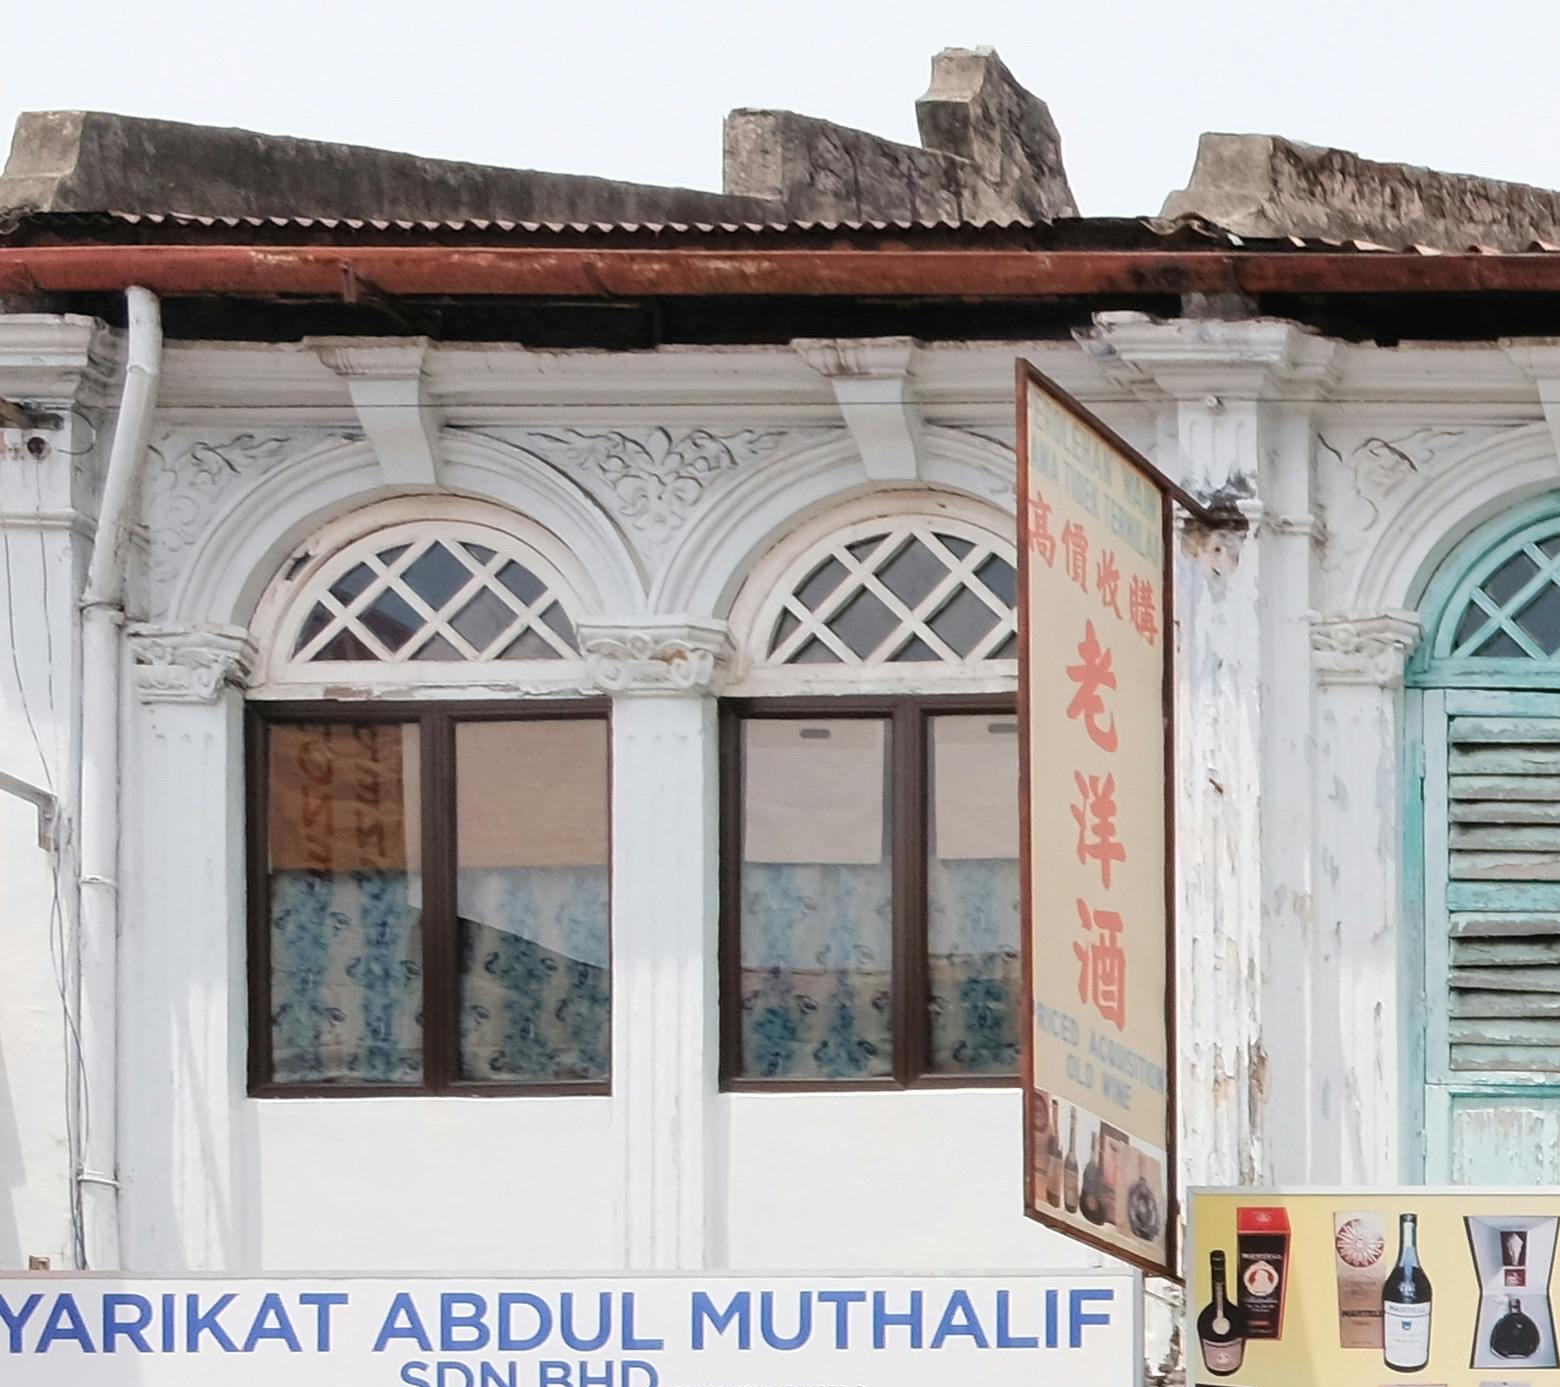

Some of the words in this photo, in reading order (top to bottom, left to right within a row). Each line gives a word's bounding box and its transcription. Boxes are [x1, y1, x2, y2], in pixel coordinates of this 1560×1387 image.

[1028, 490, 1158, 648] 高價收購
[1066, 619, 1128, 1032] 老洋酒
[1067, 1053, 1093, 1089] OLD
[0, 1292, 348, 1353] YARIKAT
[372, 1292, 663, 1351] ABDUL
[692, 1289, 1114, 1350] MUTHALIF
